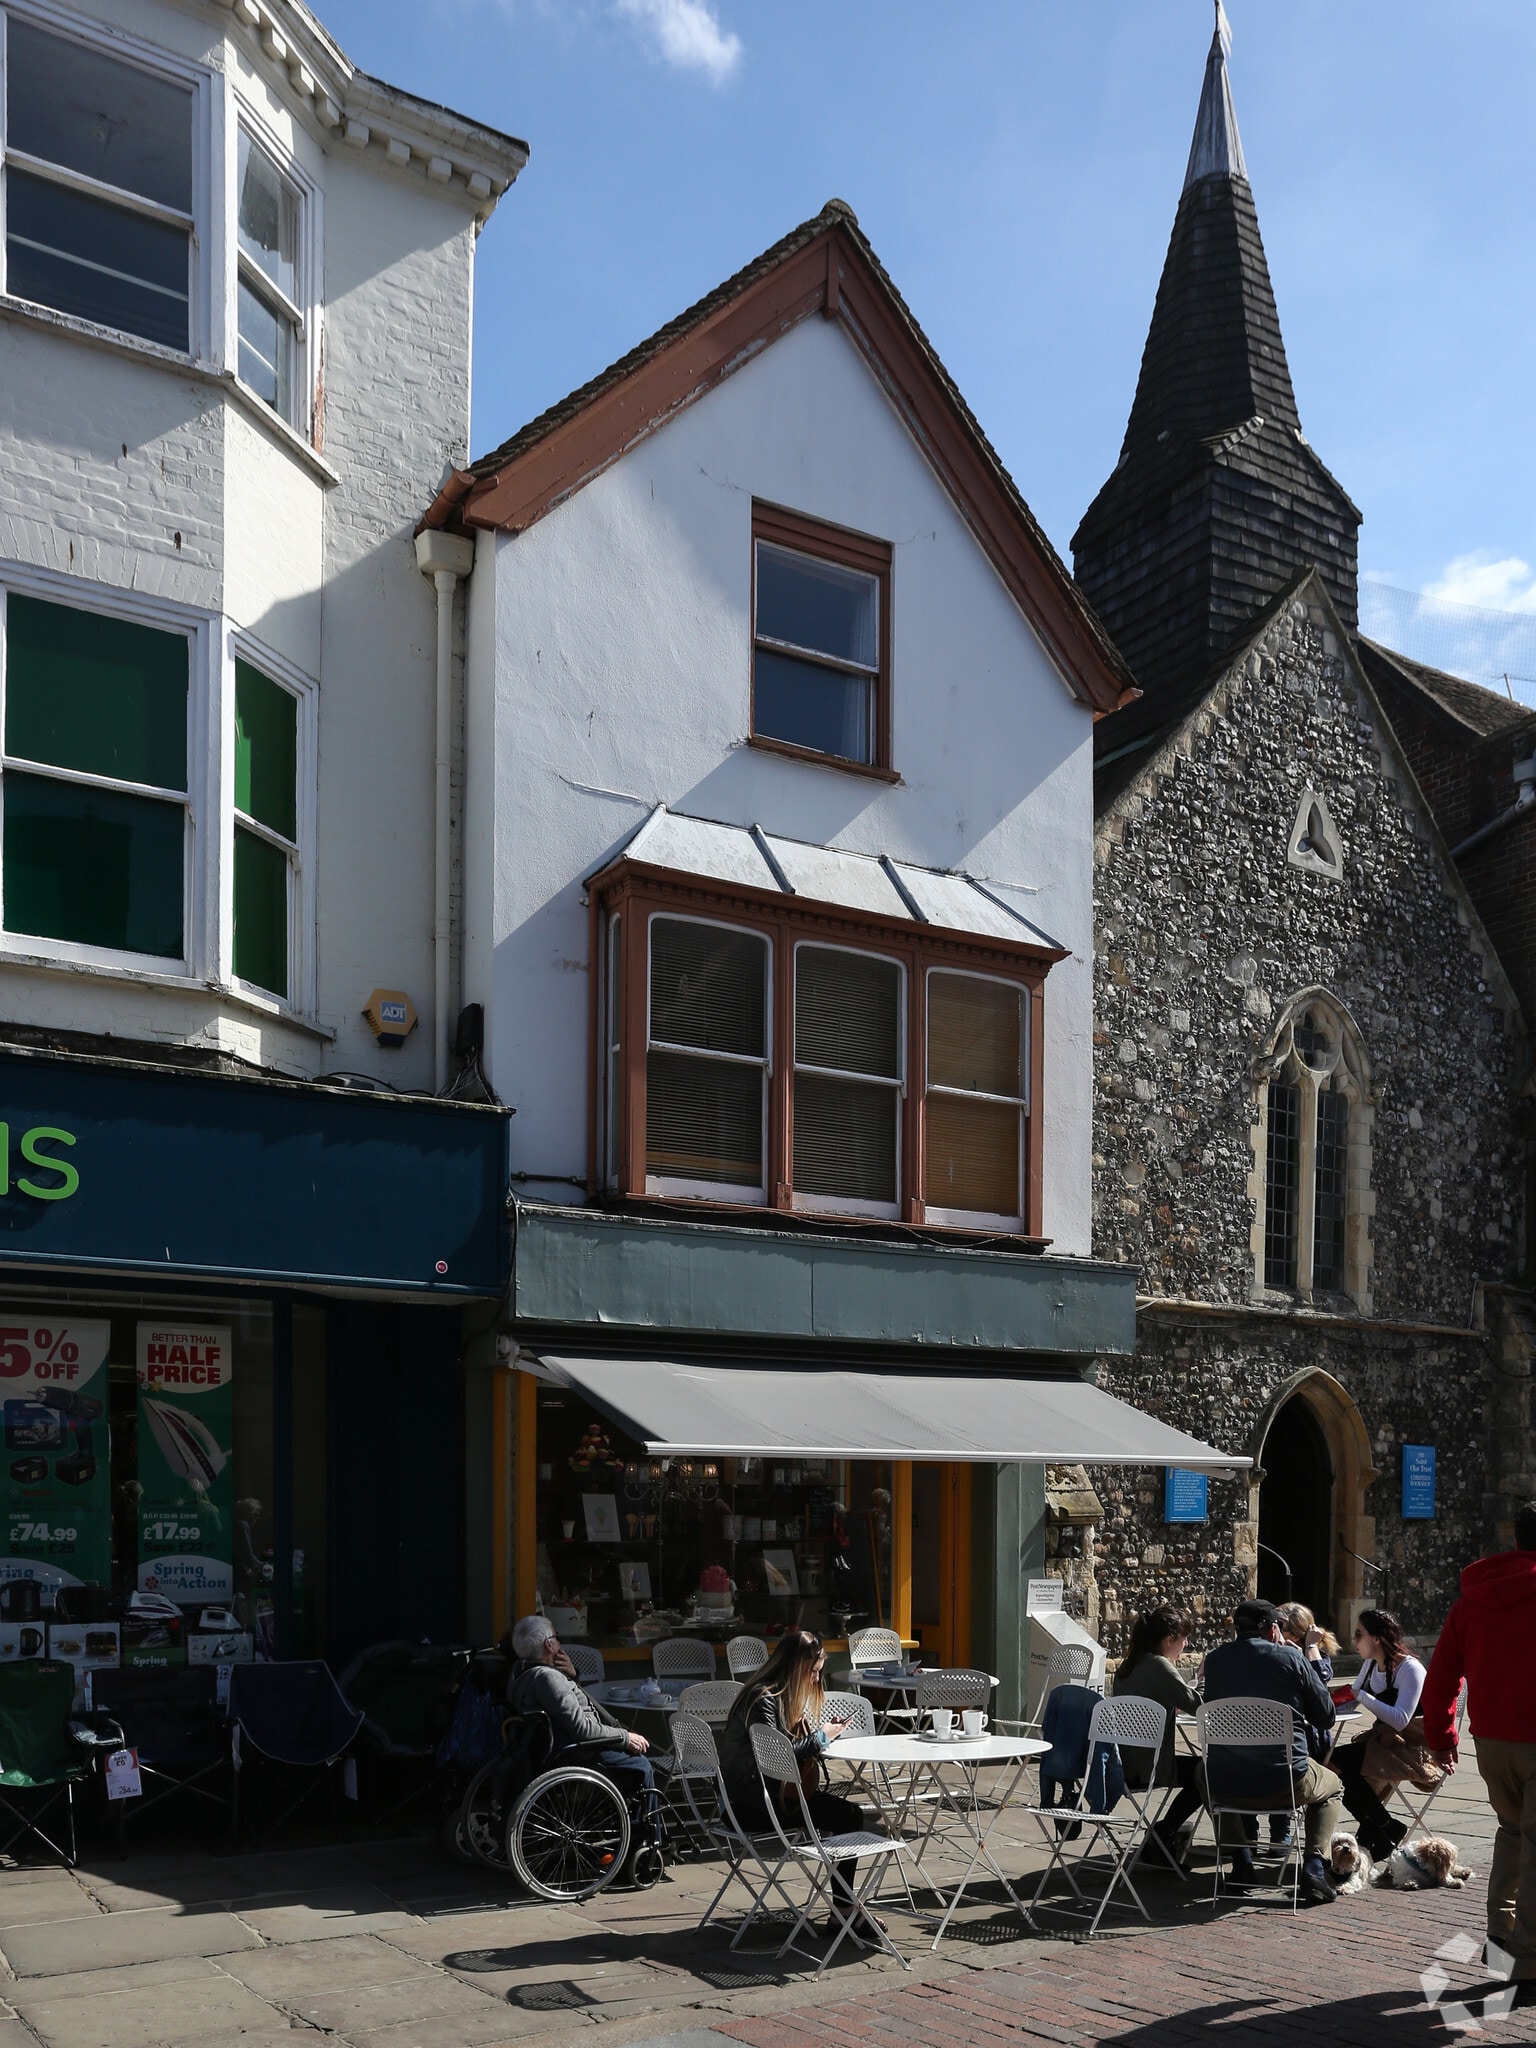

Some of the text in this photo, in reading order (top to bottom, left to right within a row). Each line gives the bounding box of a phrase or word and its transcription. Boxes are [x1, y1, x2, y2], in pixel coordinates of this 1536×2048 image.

[382, 1006, 406, 1019] ADT
[152, 1333, 217, 1344] BETTER THAN
[147, 1344, 221, 1366] HALF
[34, 1362, 80, 1380] OFF
[147, 1365, 221, 1384] PRICE
[9, 1523, 77, 1541] £74.99
[143, 1522, 201, 1540] £17.99
[10, 1543, 76, 1554] Save £25
[144, 1542, 176, 1553] Save
[154, 1563, 204, 1578] Spring
[178, 1577, 227, 1589] Action
[132, 1656, 167, 1667] Spring
